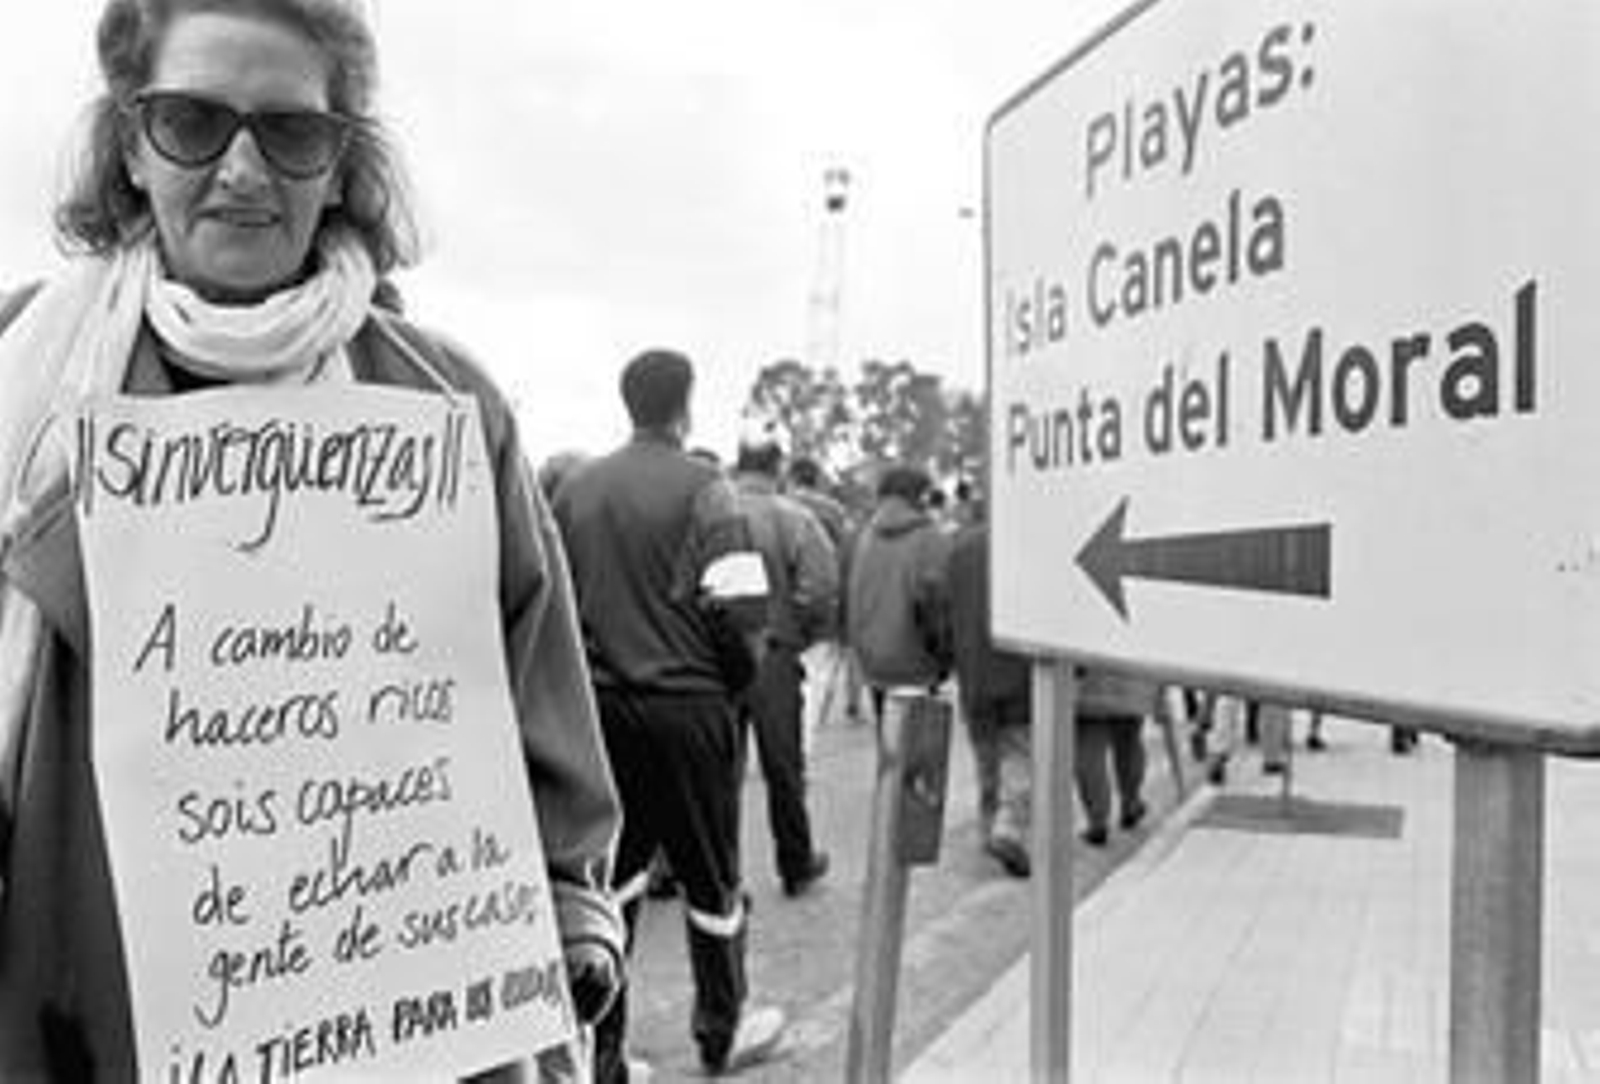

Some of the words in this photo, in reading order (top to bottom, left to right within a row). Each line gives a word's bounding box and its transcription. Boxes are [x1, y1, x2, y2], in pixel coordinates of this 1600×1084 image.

[1085, 20, 1316, 199] Playas:
[1005, 278, 1066, 355] Isla
[1087, 189, 1285, 327] Canela
[1006, 386, 1122, 472] Punta
[1143, 352, 1228, 455] del
[1262, 279, 1537, 442] Moral
[133, 603, 175, 670] A
[211, 603, 352, 664] cambio
[372, 600, 418, 652] de
[165, 689, 338, 744] haceros
[178, 777, 276, 843] sois
[192, 863, 250, 925] de
[193, 918, 312, 1029] gente
[333, 904, 385, 963] de
[255, 1006, 377, 1084] TIERRA
